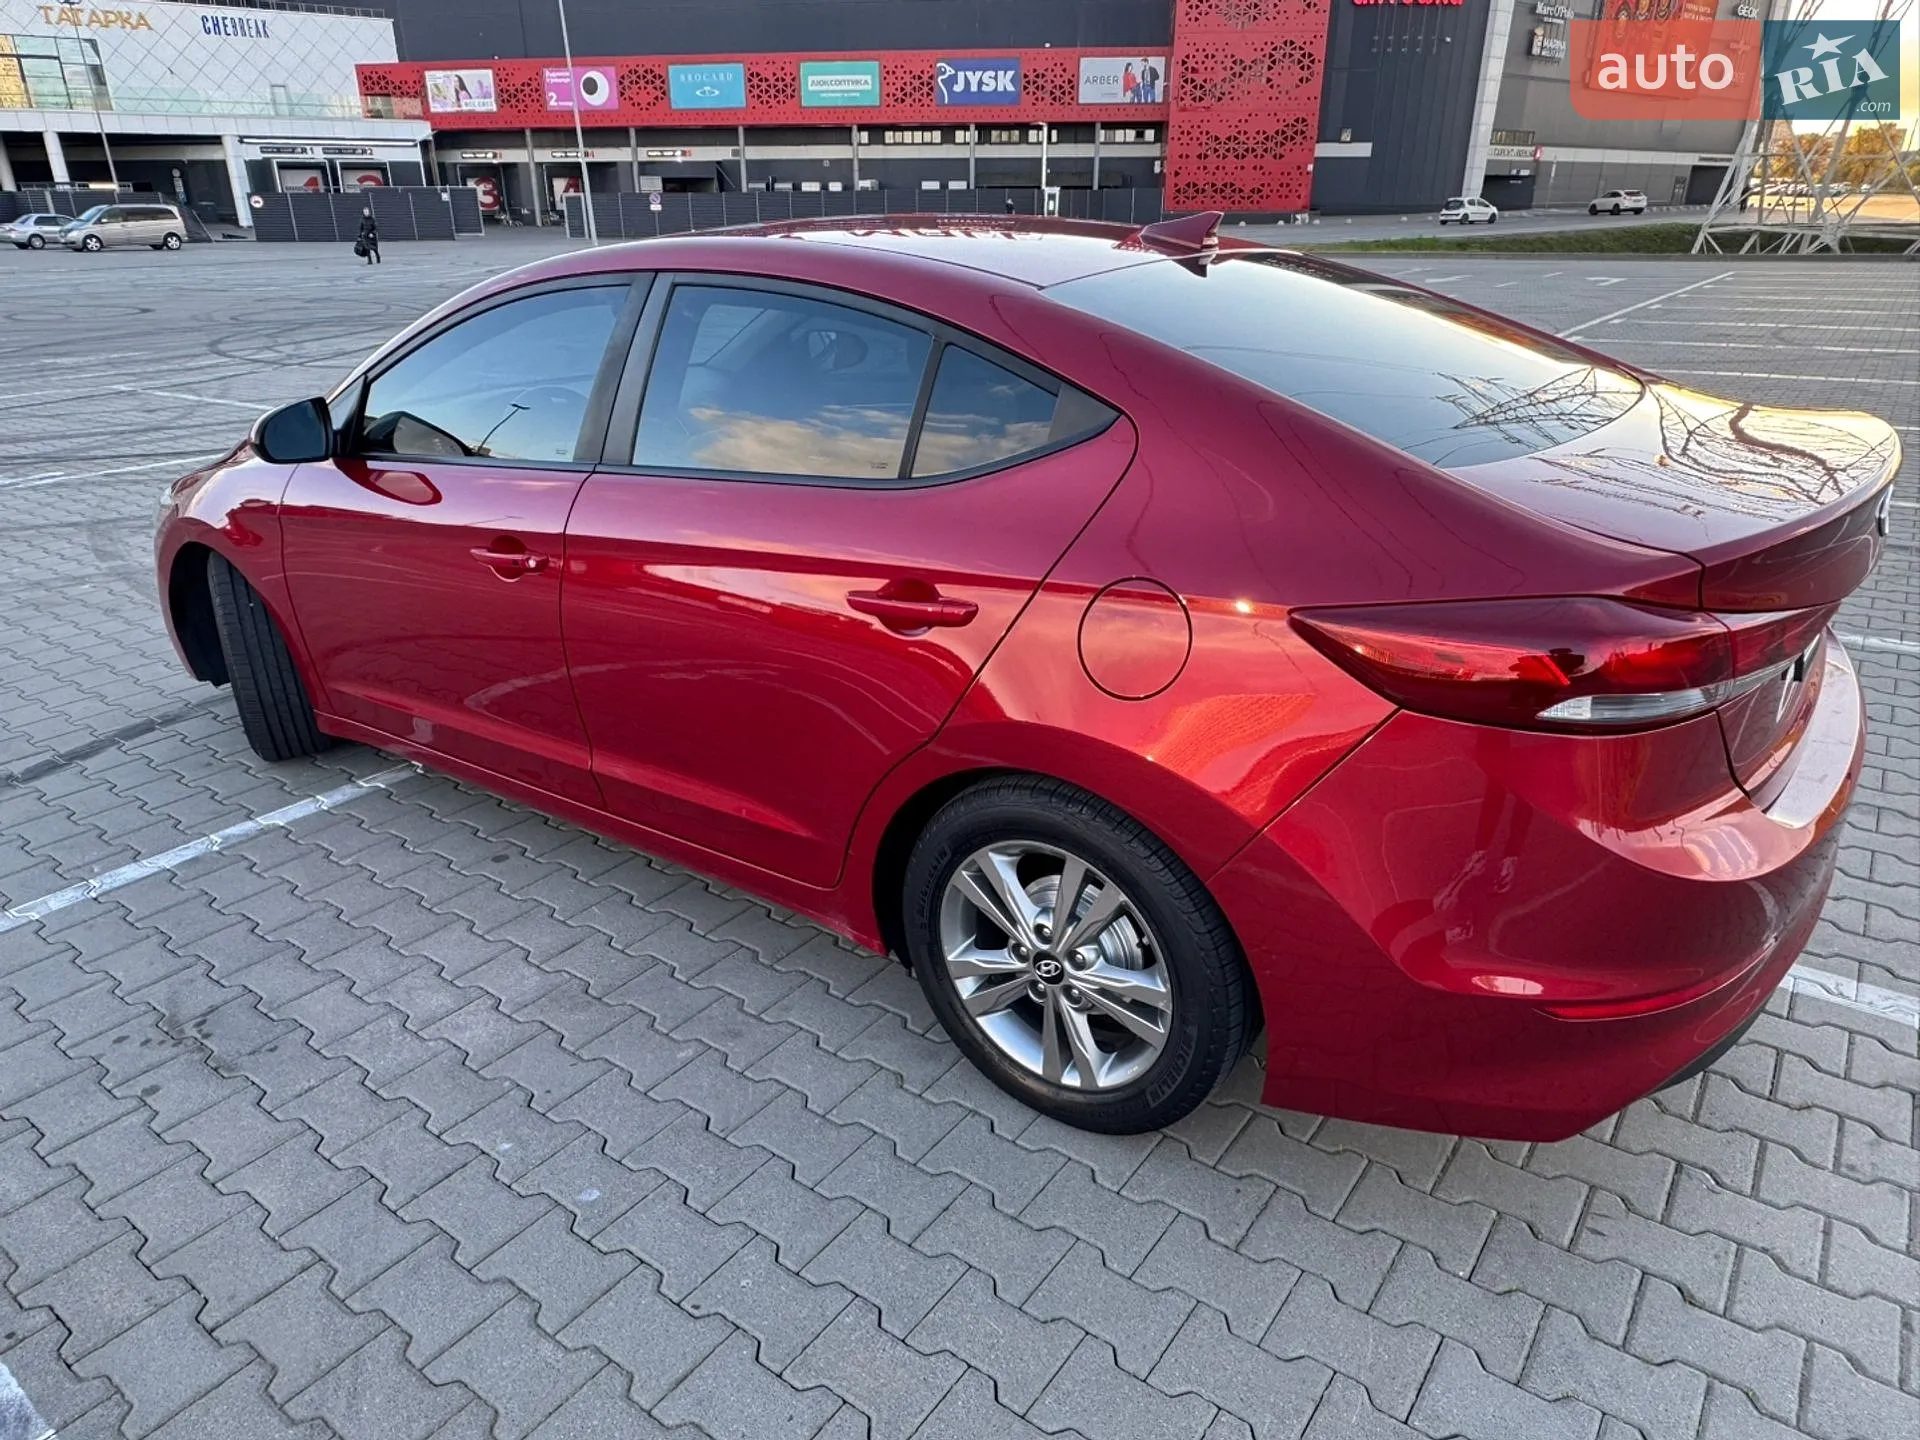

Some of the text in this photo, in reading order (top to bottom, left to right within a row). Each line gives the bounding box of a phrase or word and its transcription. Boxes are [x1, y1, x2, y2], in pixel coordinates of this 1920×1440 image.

[201, 14, 271, 40] CHEBREAK
[952, 69, 1016, 93] JYSK
[1084, 75, 1120, 86] ARBER
[547, 91, 558, 107] 2
